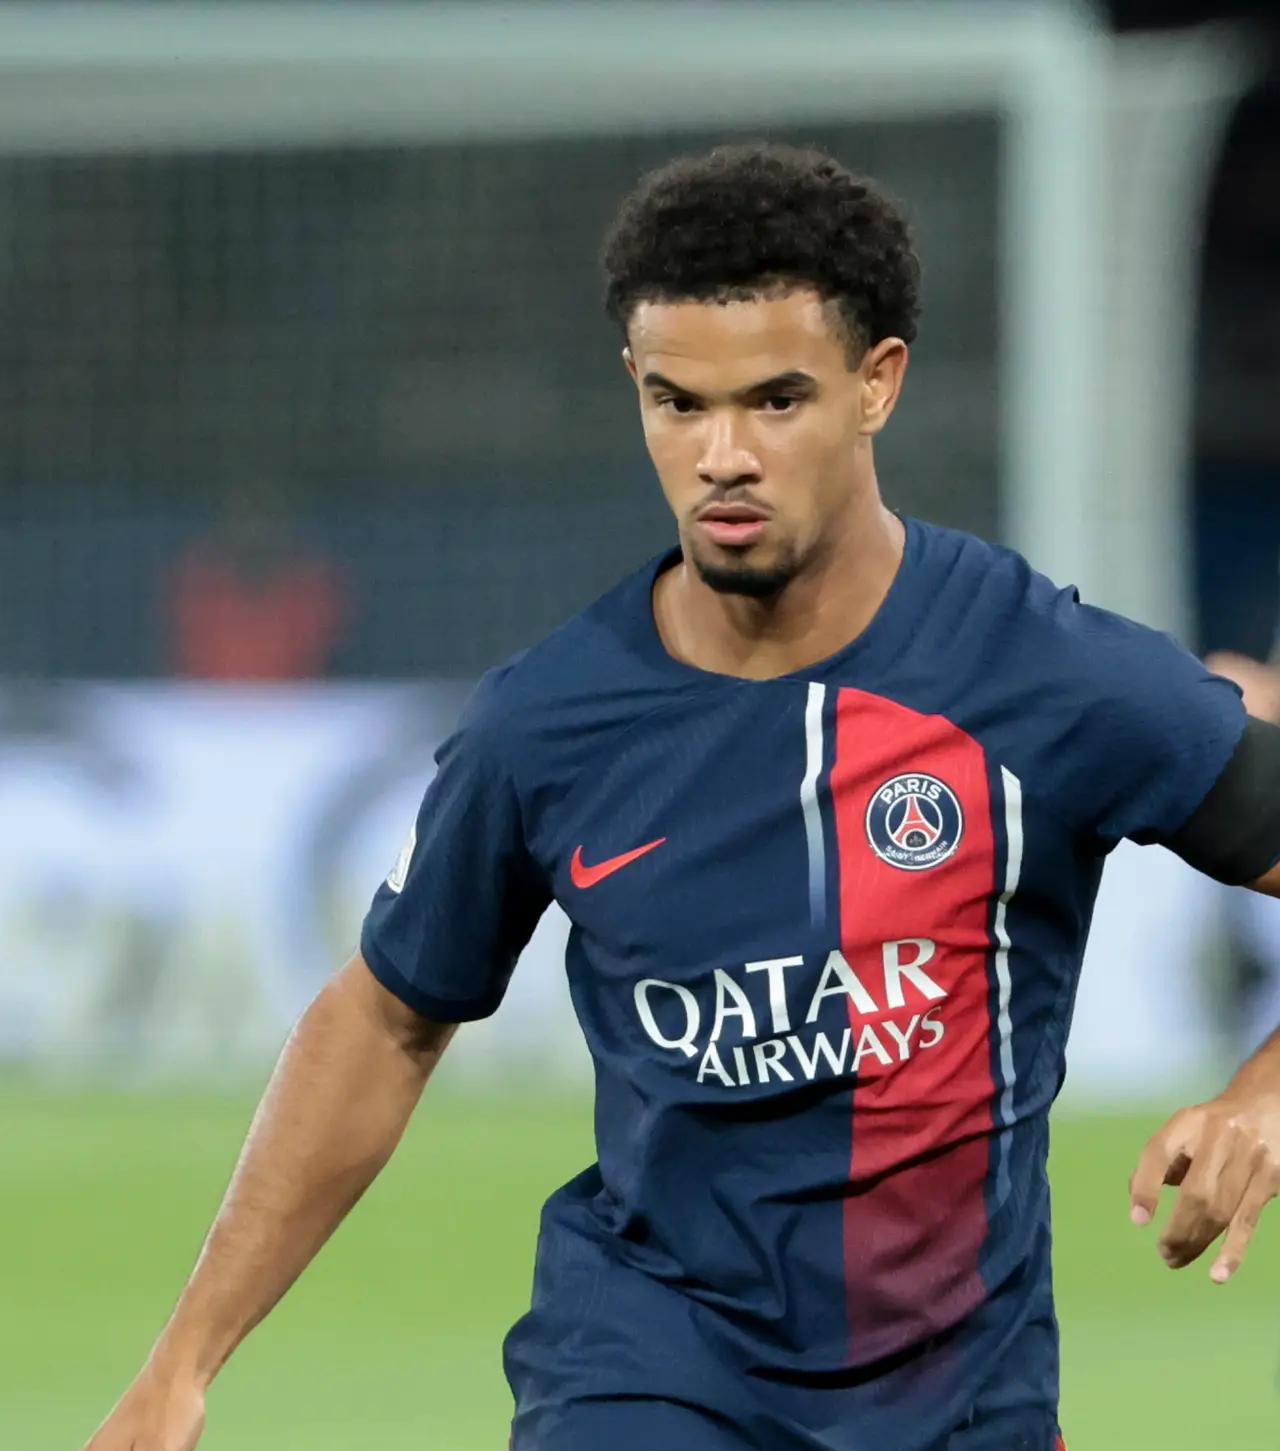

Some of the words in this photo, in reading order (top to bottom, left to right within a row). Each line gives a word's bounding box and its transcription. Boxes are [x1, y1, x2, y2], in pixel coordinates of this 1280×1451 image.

[880, 778, 942, 805] PARIS
[632, 937, 949, 1059] QATAR
[696, 1005, 945, 1088] AIRWAYS
